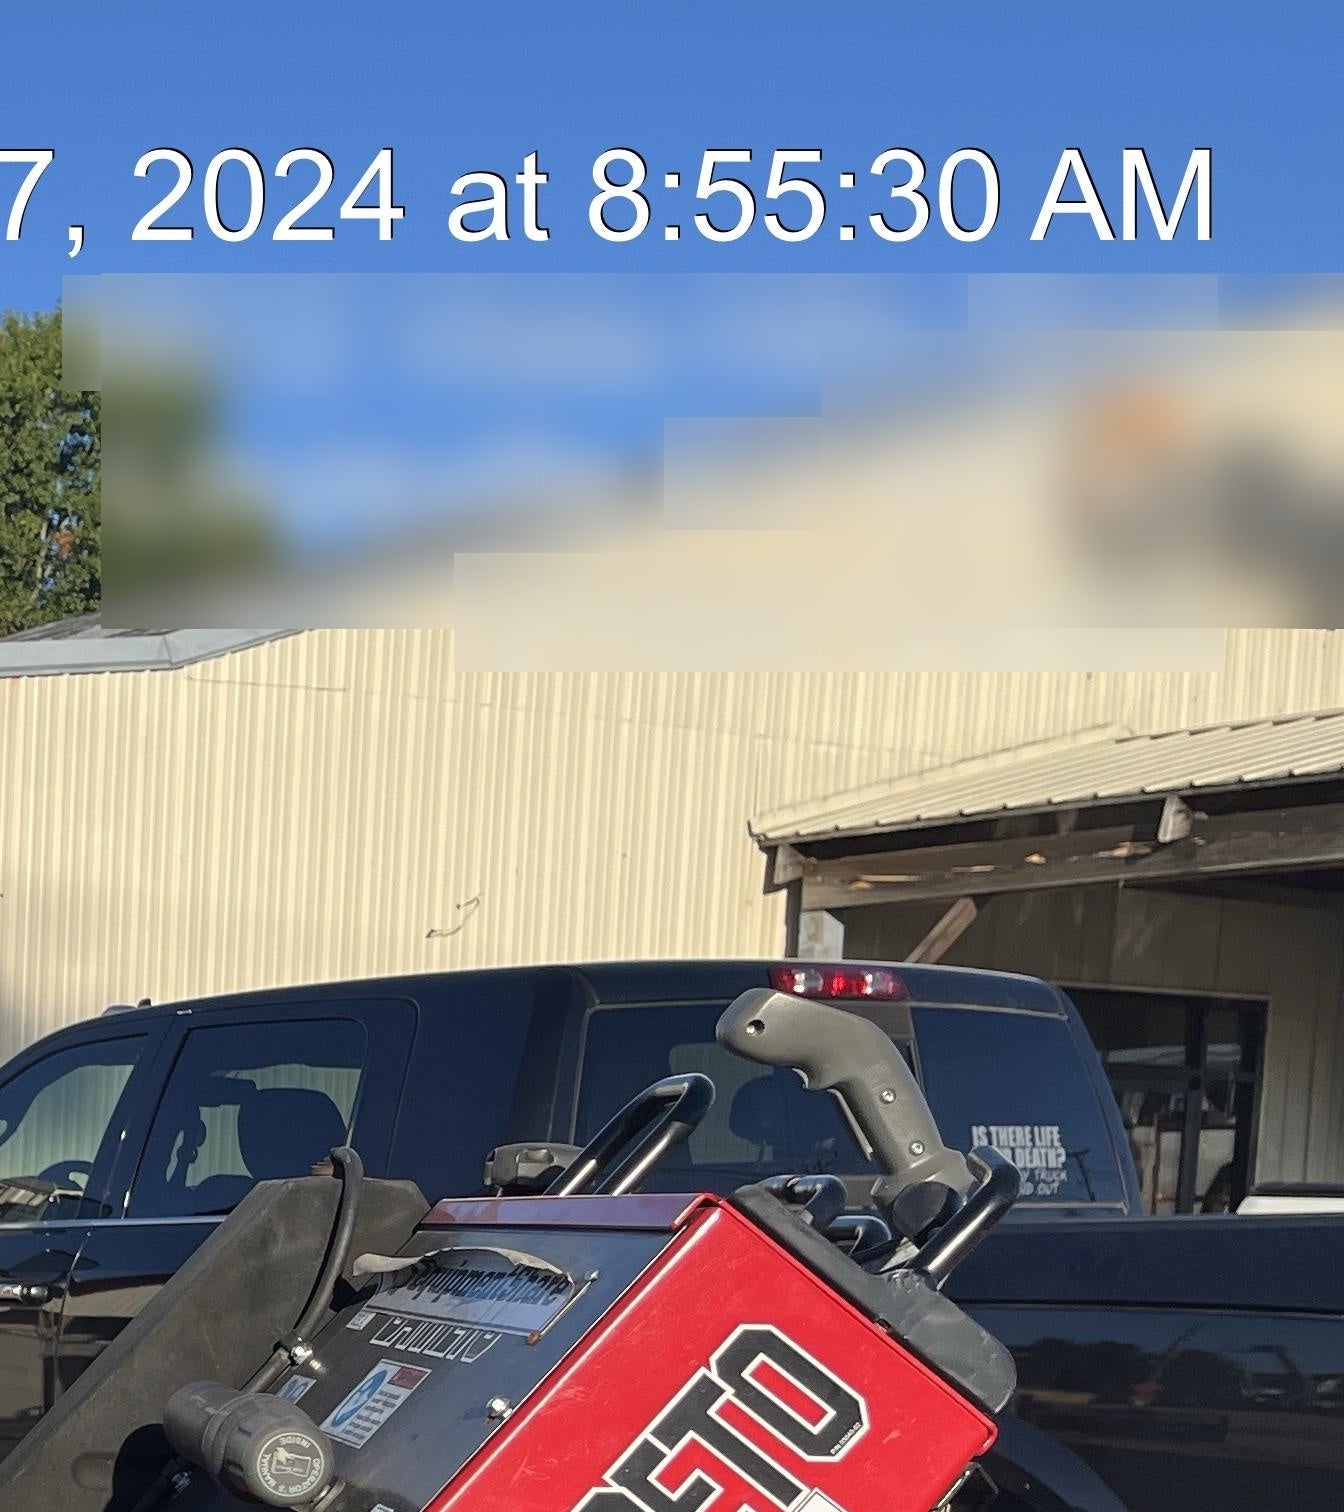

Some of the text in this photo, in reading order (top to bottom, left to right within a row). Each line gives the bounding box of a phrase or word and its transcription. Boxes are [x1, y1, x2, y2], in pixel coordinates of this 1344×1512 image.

[971, 1125, 1061, 1147] IS THERE LIFE
[1014, 1147, 1066, 1169] DEATH?
[280, 1436, 311, 1448] INSIDE
[262, 1453, 321, 1494] OPERATOR'S MANUAL
